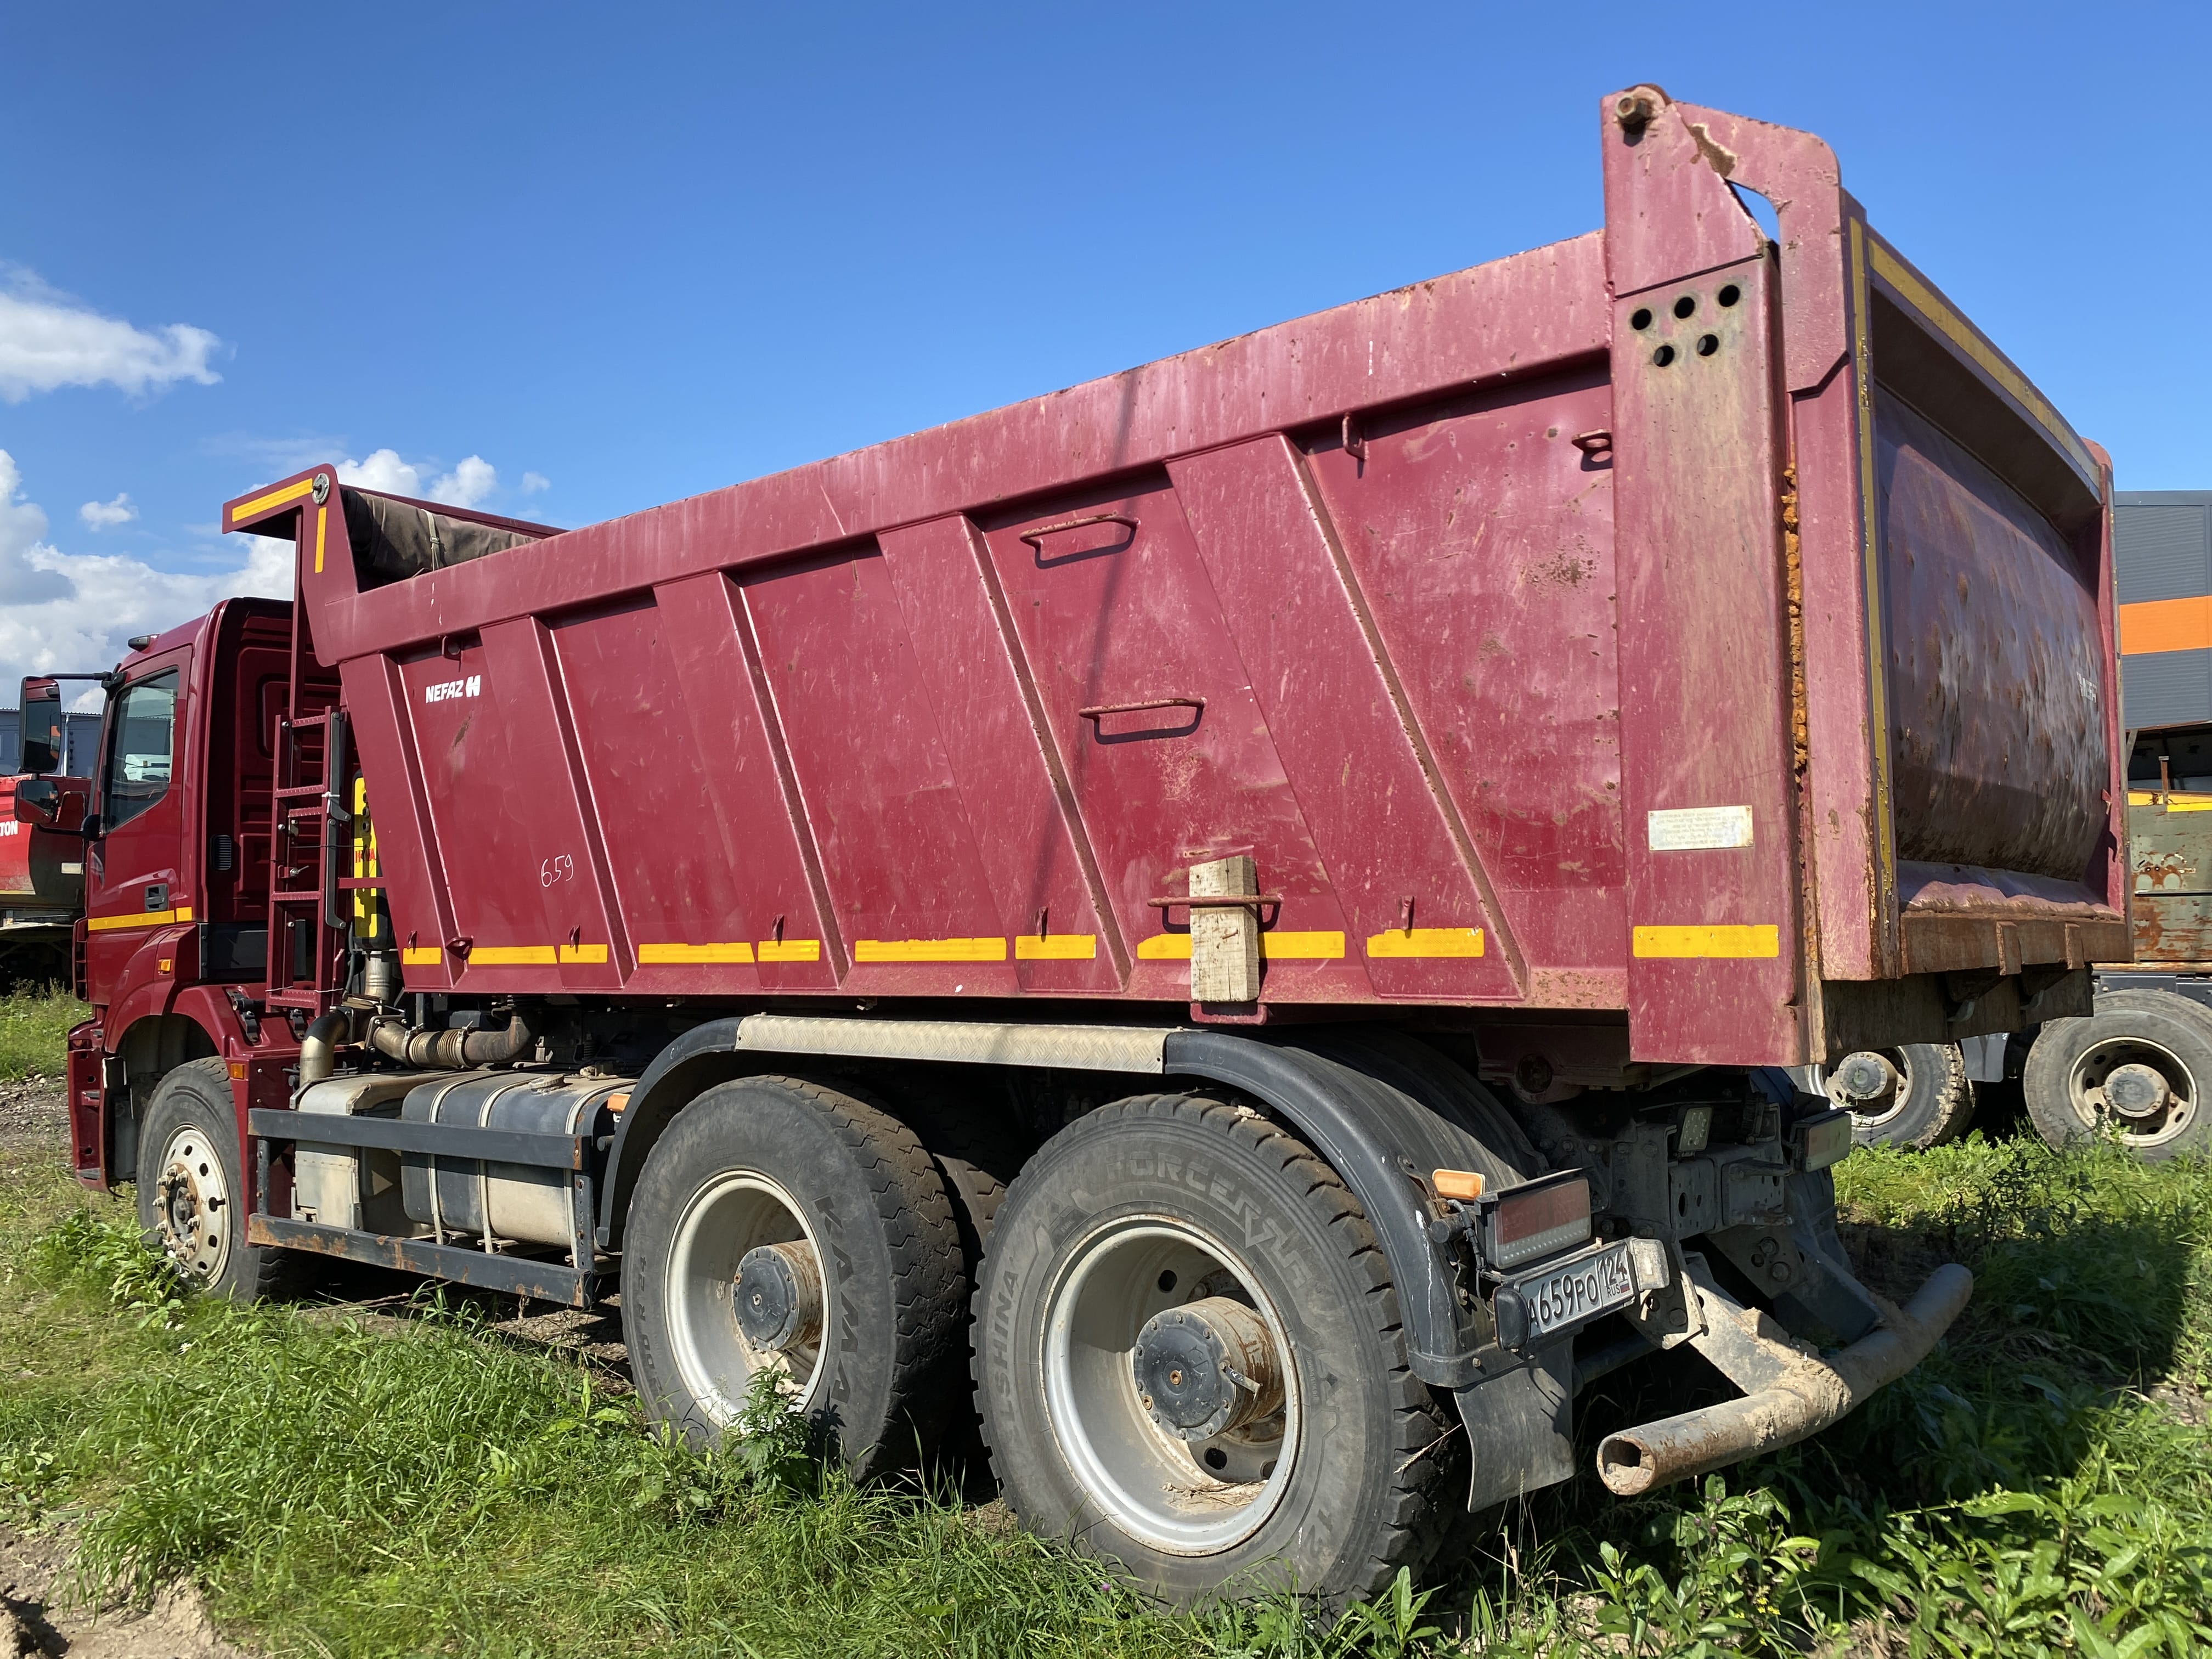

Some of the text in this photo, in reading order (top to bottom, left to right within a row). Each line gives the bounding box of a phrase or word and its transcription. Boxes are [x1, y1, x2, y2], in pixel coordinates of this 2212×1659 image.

[426, 680, 464, 703] NEFAZ
[0, 820, 18, 837] TON
[541, 854, 574, 887] 659
[1598, 1250, 1628, 1287] 124
[814, 1196, 859, 1404] KAMA
[1606, 1284, 1621, 1298] RUS
